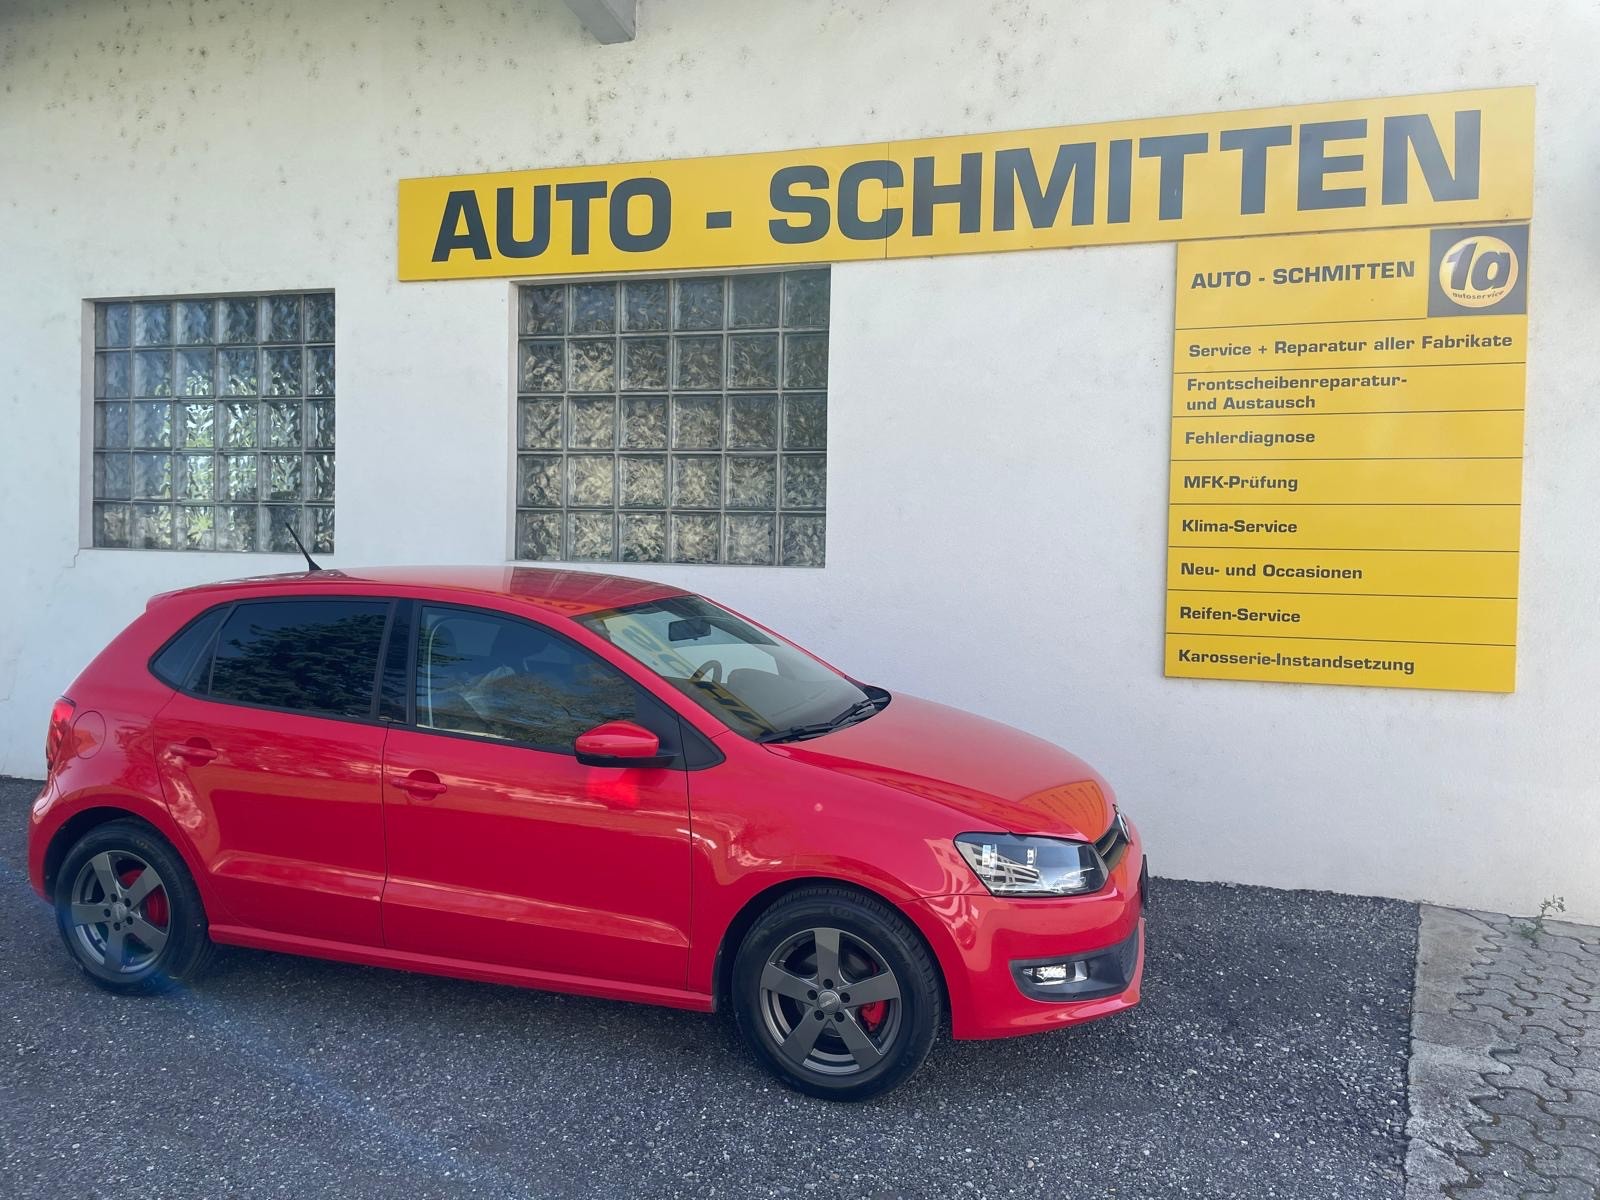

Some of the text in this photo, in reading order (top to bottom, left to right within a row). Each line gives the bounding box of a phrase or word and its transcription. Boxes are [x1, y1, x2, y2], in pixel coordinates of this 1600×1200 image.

[431, 109, 1482, 262] AUTO - SCHMITTEN
[1446, 241, 1511, 291] 1a
[1191, 270, 1252, 290] AUTO
[1272, 260, 1415, 285] SCHMITTEN
[1188, 334, 1513, 358] Service + Reparatur aller Fabrikate
[1186, 375, 1408, 392] Frontscheibenreparatur-
[1186, 395, 1316, 411] und Austausch
[1184, 430, 1316, 447] Fehlerdiagnose
[1183, 475, 1299, 492] MFK-Prüfung
[1181, 519, 1298, 534] Klima-Service
[1180, 562, 1363, 580] Neu- und Occasionen
[1179, 606, 1301, 623] Reifen-Service
[1178, 649, 1415, 675] Karosserie-Instandsetzung
